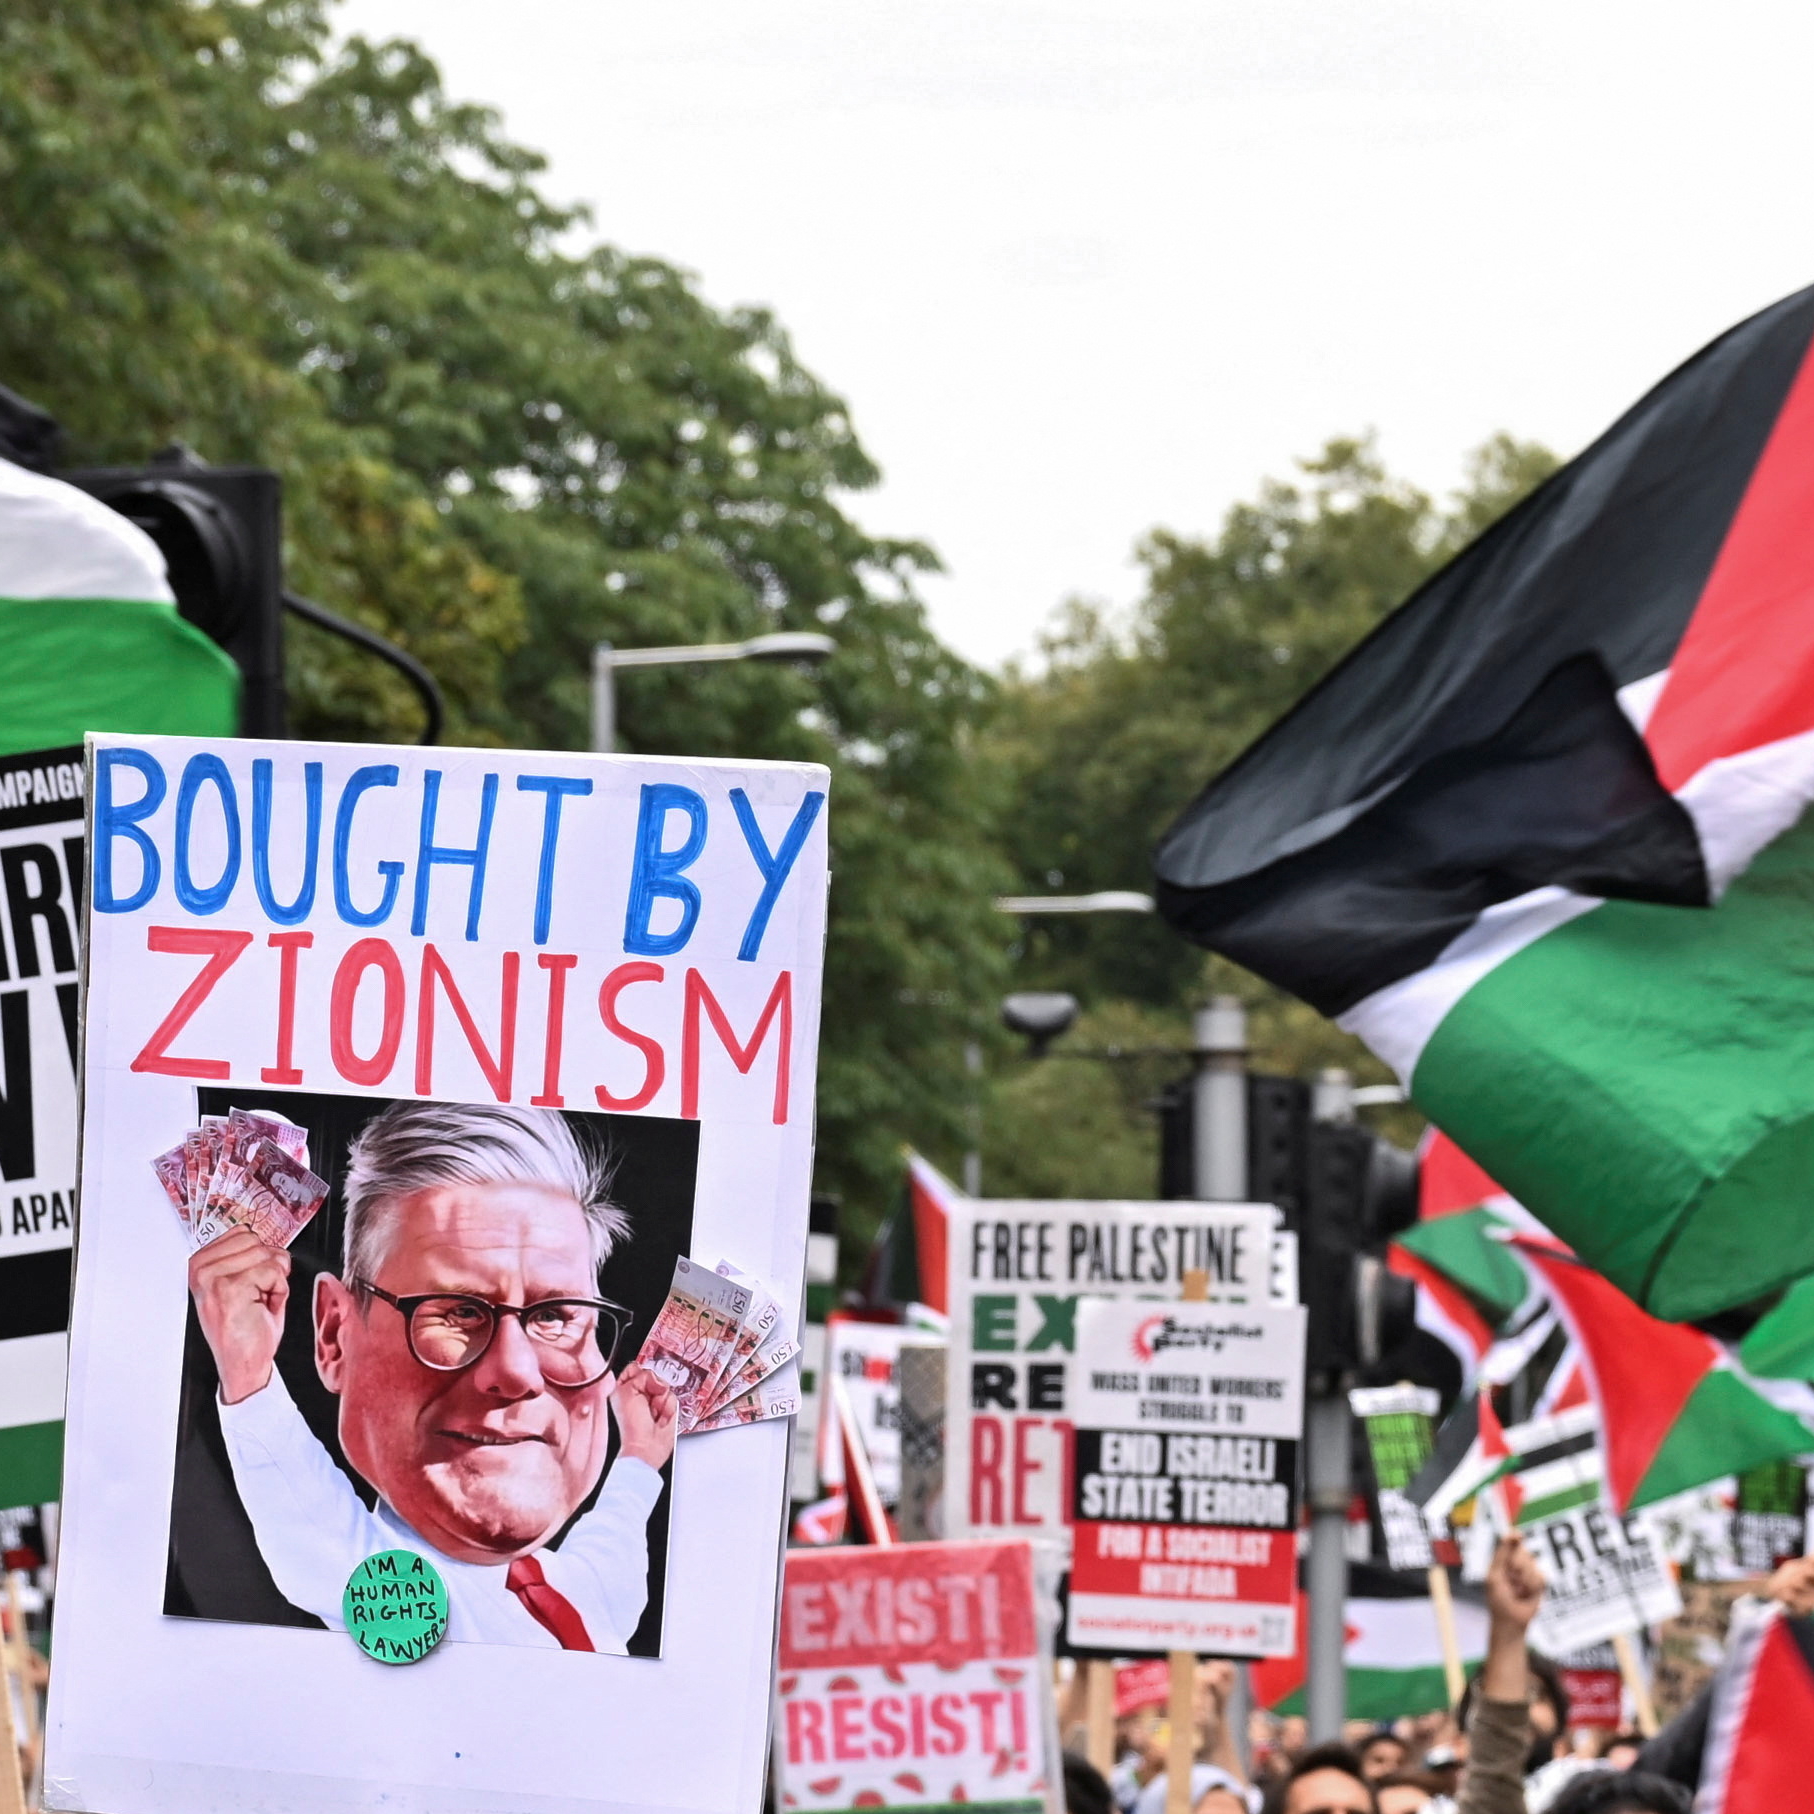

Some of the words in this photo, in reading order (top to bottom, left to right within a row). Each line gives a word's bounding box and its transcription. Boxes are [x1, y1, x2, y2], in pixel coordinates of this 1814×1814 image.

[93, 747, 592, 945] BOUGHT
[624, 783, 825, 962] BY
[129, 925, 792, 1126] ZIONISM
[13, 1188, 75, 1236] APA
[971, 1220, 1054, 1282] FREE
[1068, 1222, 1247, 1285] PALESTINE
[1099, 1430, 1162, 1476] END
[1166, 1435, 1277, 1481] ISRAELI
[1081, 1472, 1176, 1522] STATE
[1178, 1479, 1289, 1526] TERROR
[364, 1555, 398, 1580] I'M
[411, 1557, 423, 1576] A
[1097, 1524, 1144, 1560] FOR
[1145, 1526, 1164, 1560] A
[1166, 1527, 1273, 1567] SOCIALIST
[353, 1602, 437, 1625] RIGHTS
[788, 1573, 1001, 1658] EXIST!
[786, 1689, 1030, 1773] RESIST!
